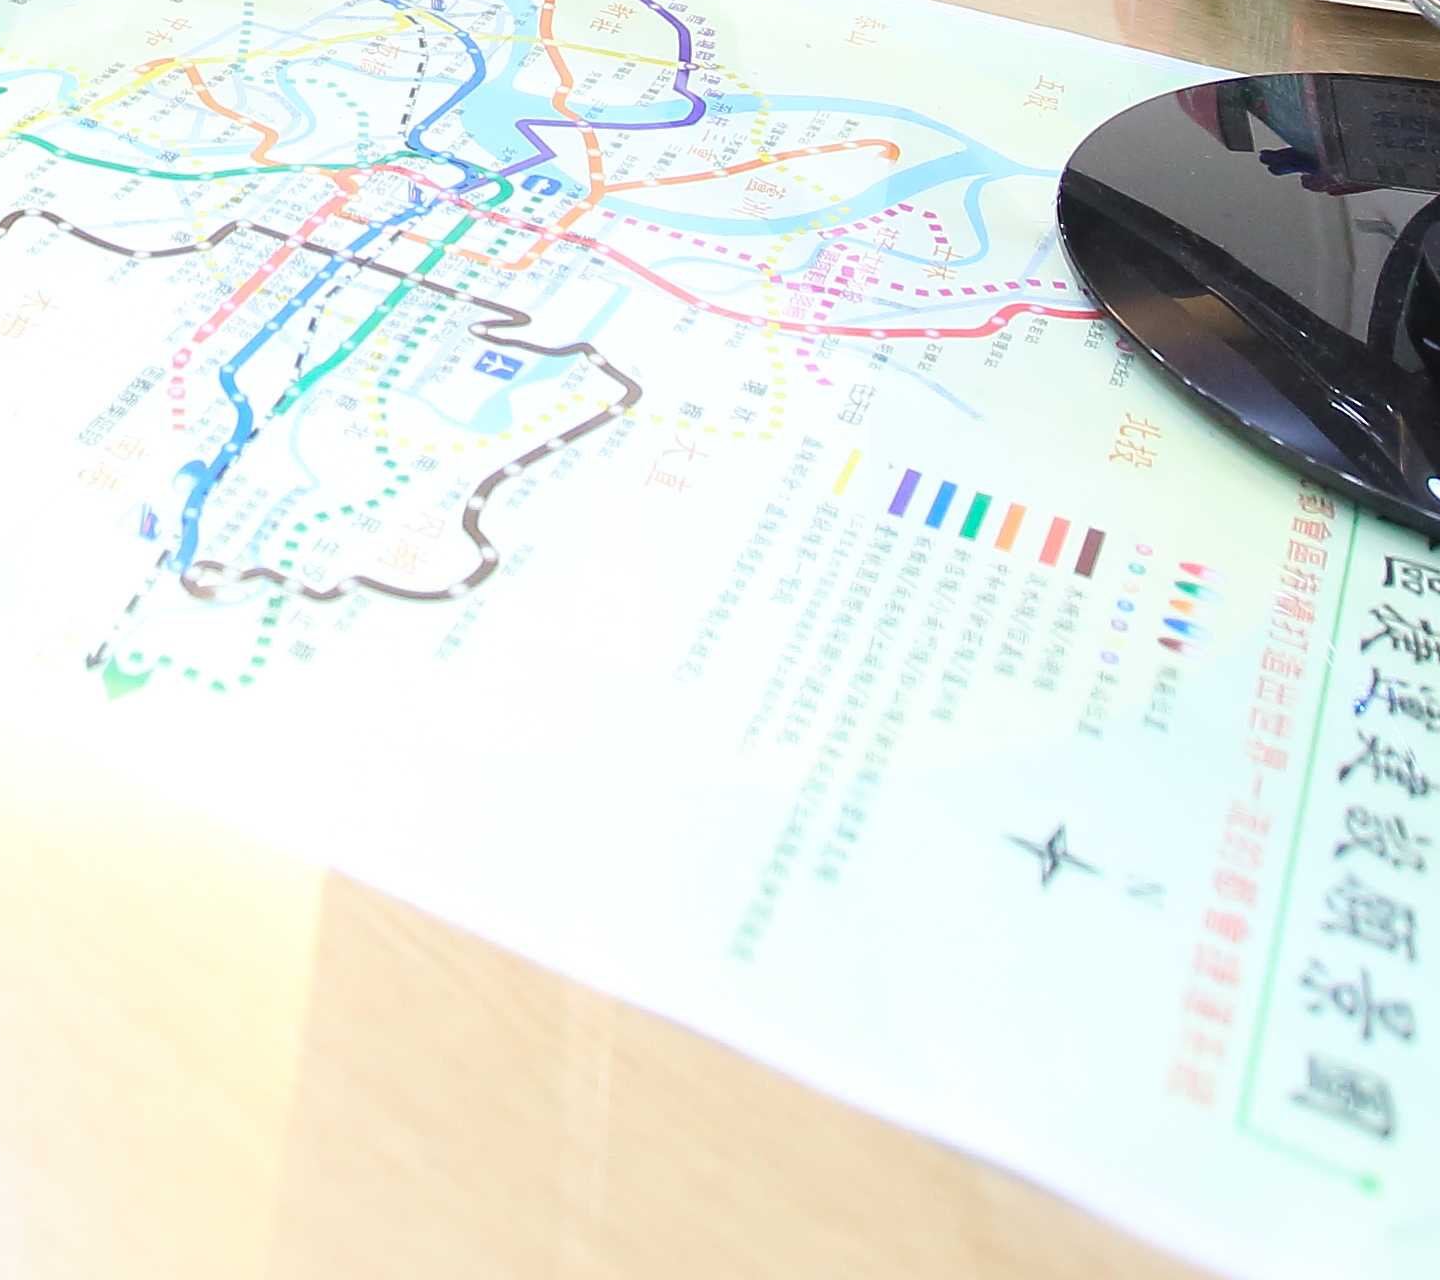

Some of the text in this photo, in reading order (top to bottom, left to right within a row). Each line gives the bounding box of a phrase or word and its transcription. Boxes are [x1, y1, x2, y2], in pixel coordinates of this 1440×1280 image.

[136, 12, 197, 51] 中和
[587, 0, 638, 37] 新莊
[843, 12, 892, 52] 泰山
[353, 39, 408, 79] 板橋
[1021, 73, 1067, 114] 五股
[684, 125, 728, 163] 三重
[731, 175, 789, 222] 蘆洲
[918, 240, 966, 286] 士林
[72, 362, 168, 448] 信義線東延段
[835, 379, 877, 428] 往天母
[72, 427, 157, 499] 南港
[642, 430, 713, 501] 大直
[1106, 409, 1164, 476] 北投
[375, 506, 449, 577] 內湖
